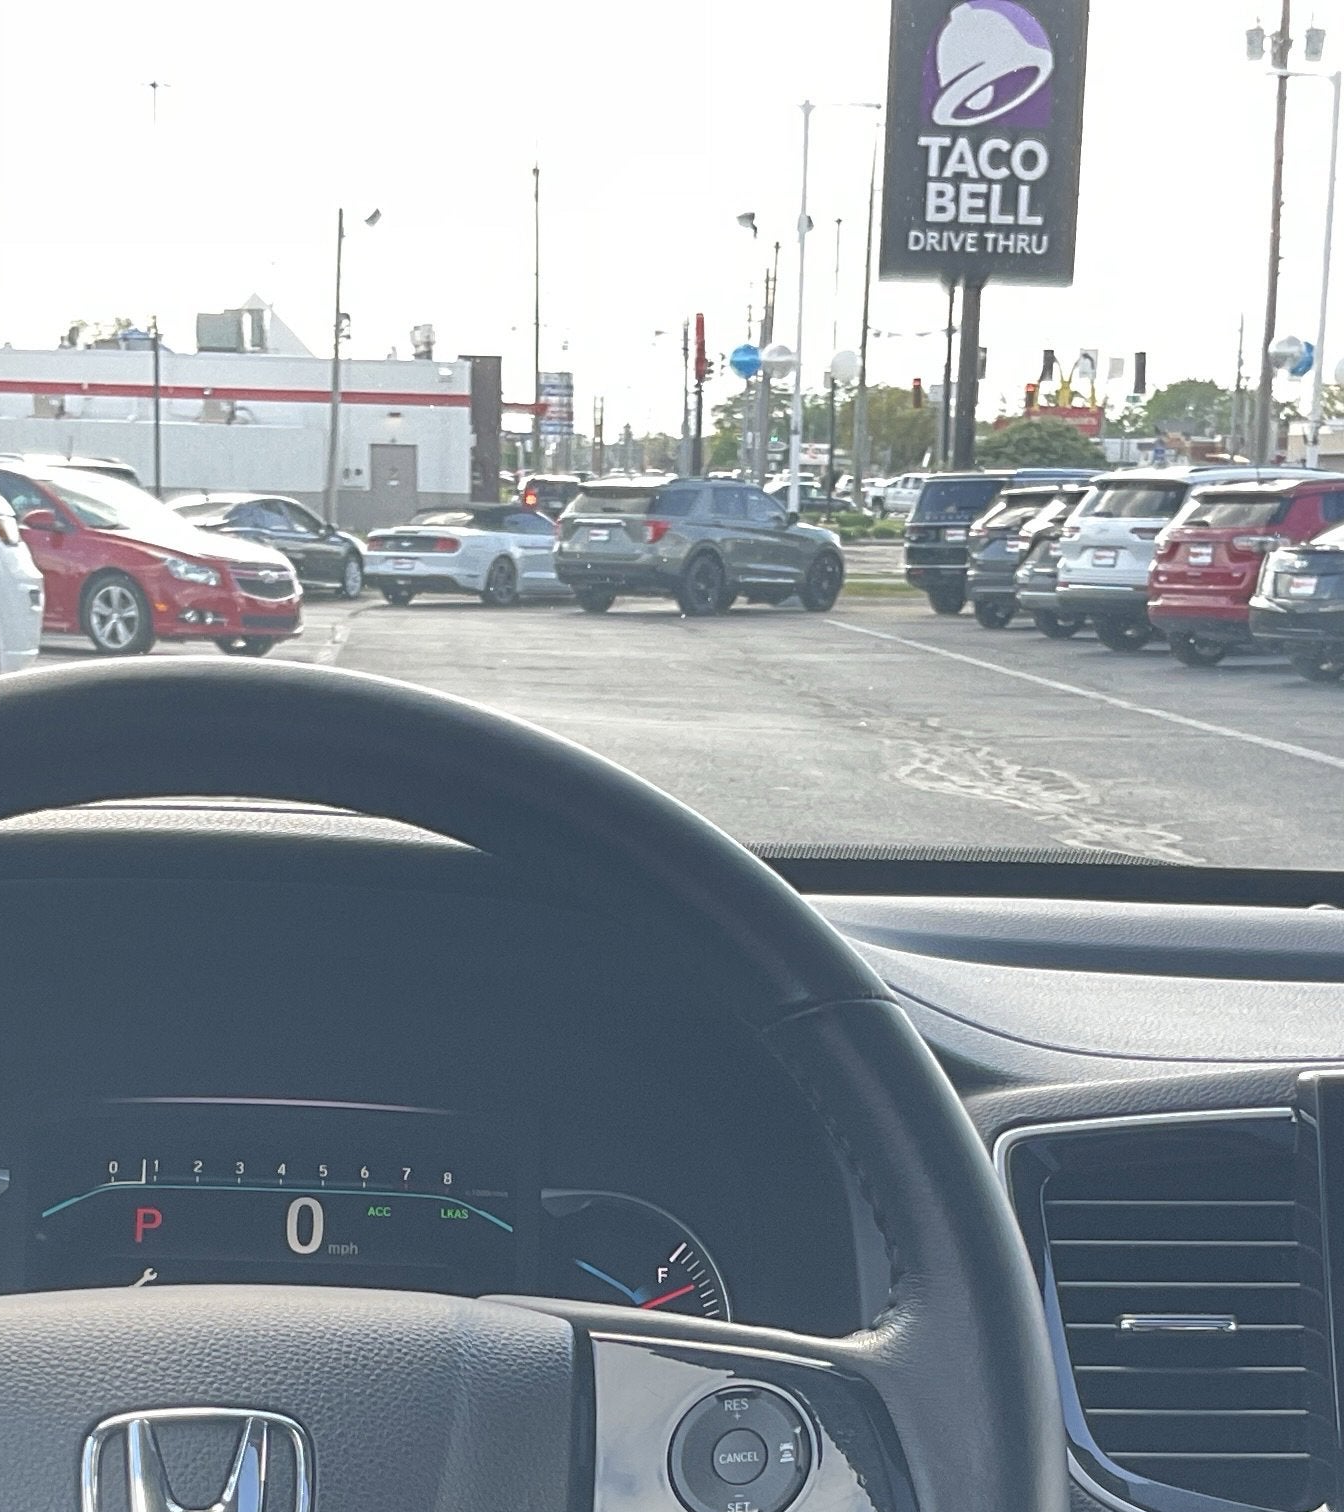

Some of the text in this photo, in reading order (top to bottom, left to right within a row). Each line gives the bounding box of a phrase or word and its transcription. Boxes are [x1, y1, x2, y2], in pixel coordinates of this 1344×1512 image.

[917, 136, 1049, 181] TACO
[925, 181, 1043, 225] BELL
[908, 230, 1048, 254] DRIVE THRU
[109, 1160, 452, 1184] 0 1 2 3 4 5 6 7 8
[368, 1207, 390, 1216] ACC
[441, 1208, 469, 1219] LKAS
[135, 1207, 162, 1243] P
[287, 1198, 358, 1255] 0 mph
[658, 1268, 668, 1283] F
[724, 1399, 749, 1412] RES
[719, 1453, 760, 1464] CANCEL
